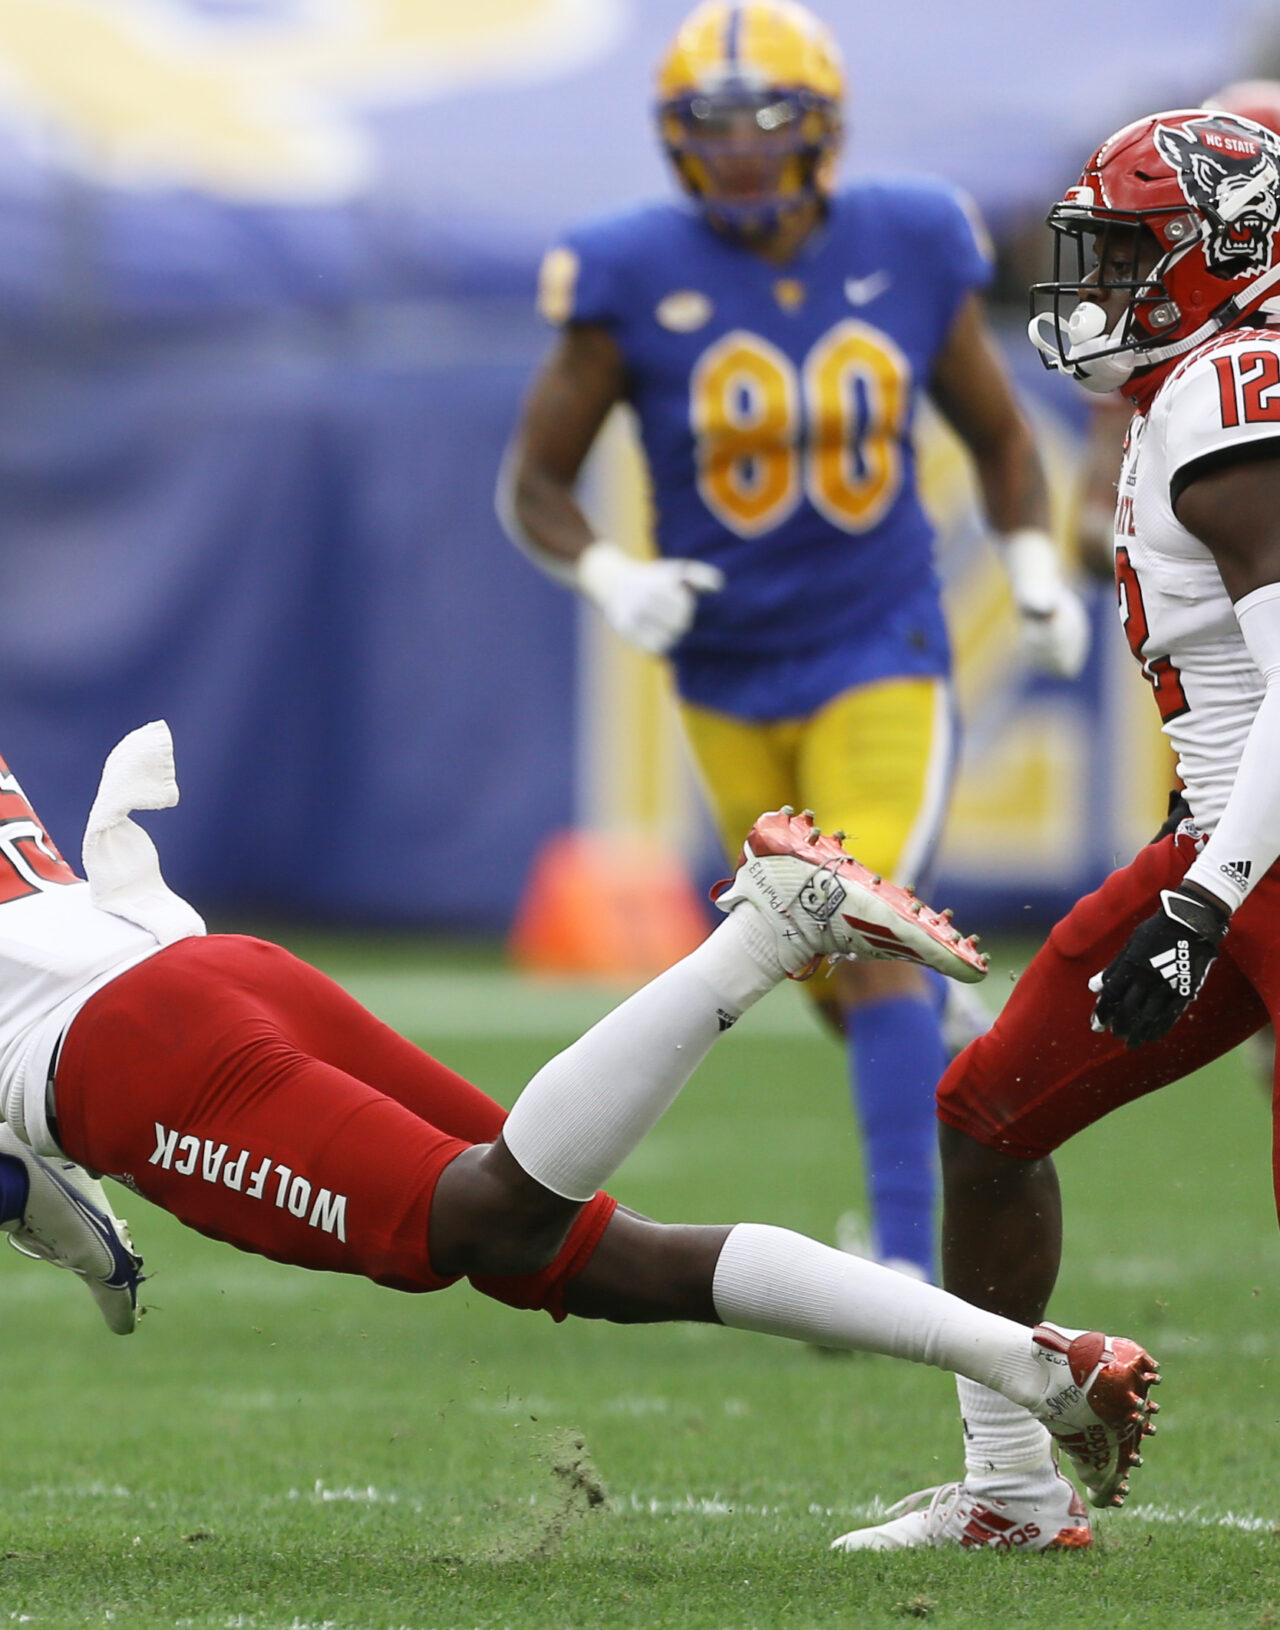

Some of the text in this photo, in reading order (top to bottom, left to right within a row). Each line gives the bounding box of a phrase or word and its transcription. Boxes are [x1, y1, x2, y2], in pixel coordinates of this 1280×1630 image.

[1205, 133, 1256, 155] NC STATE
[1209, 350, 1280, 429] 12
[688, 317, 911, 540] 80
[1176, 939, 1191, 997] adidas
[147, 1121, 348, 1244] WOLFPACK
[1045, 1384, 1085, 1416] SNIPER
